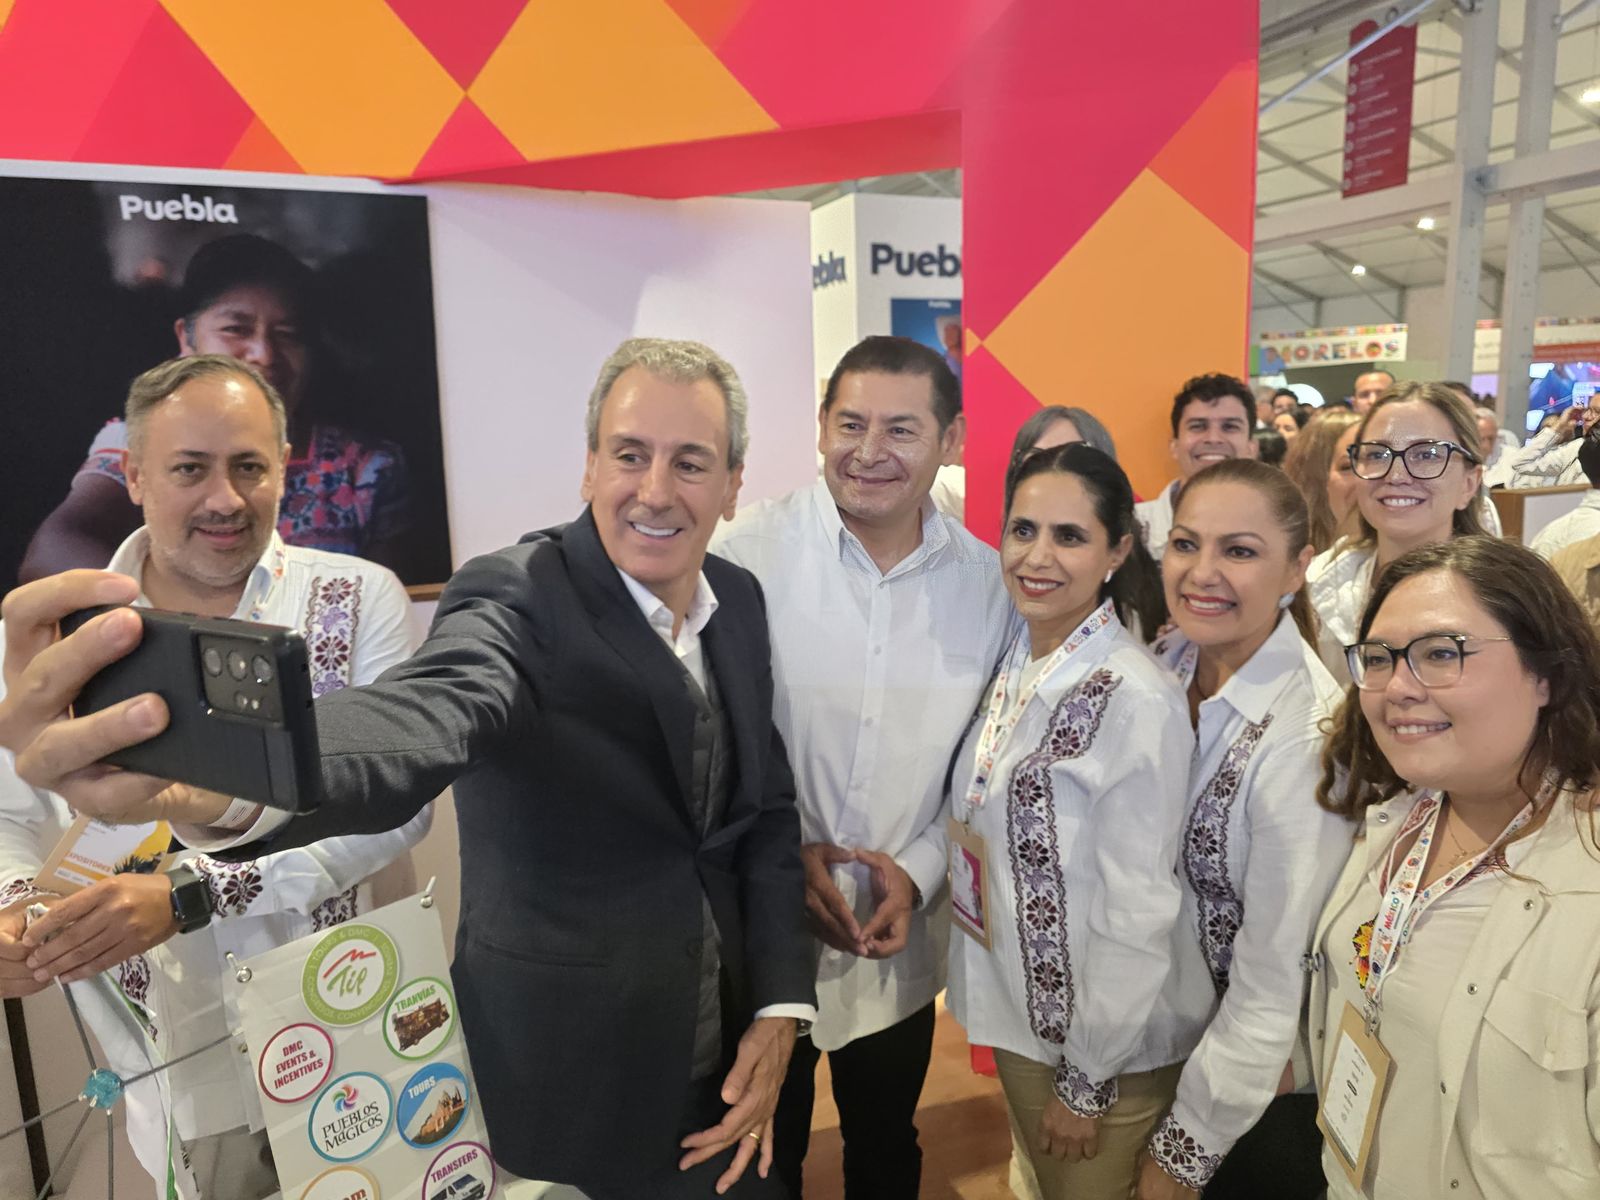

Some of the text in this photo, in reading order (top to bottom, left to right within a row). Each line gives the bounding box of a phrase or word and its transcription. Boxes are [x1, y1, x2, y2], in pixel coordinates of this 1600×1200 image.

[119, 193, 238, 223] Puebla
[347, 928, 370, 937] DMC
[282, 1040, 304, 1057] DMC
[274, 1058, 324, 1089] INCENTIVES
[275, 1049, 317, 1074] EVENTS &
[408, 1075, 436, 1099] TOURS
[431, 1149, 478, 1183] TRANSFERS
